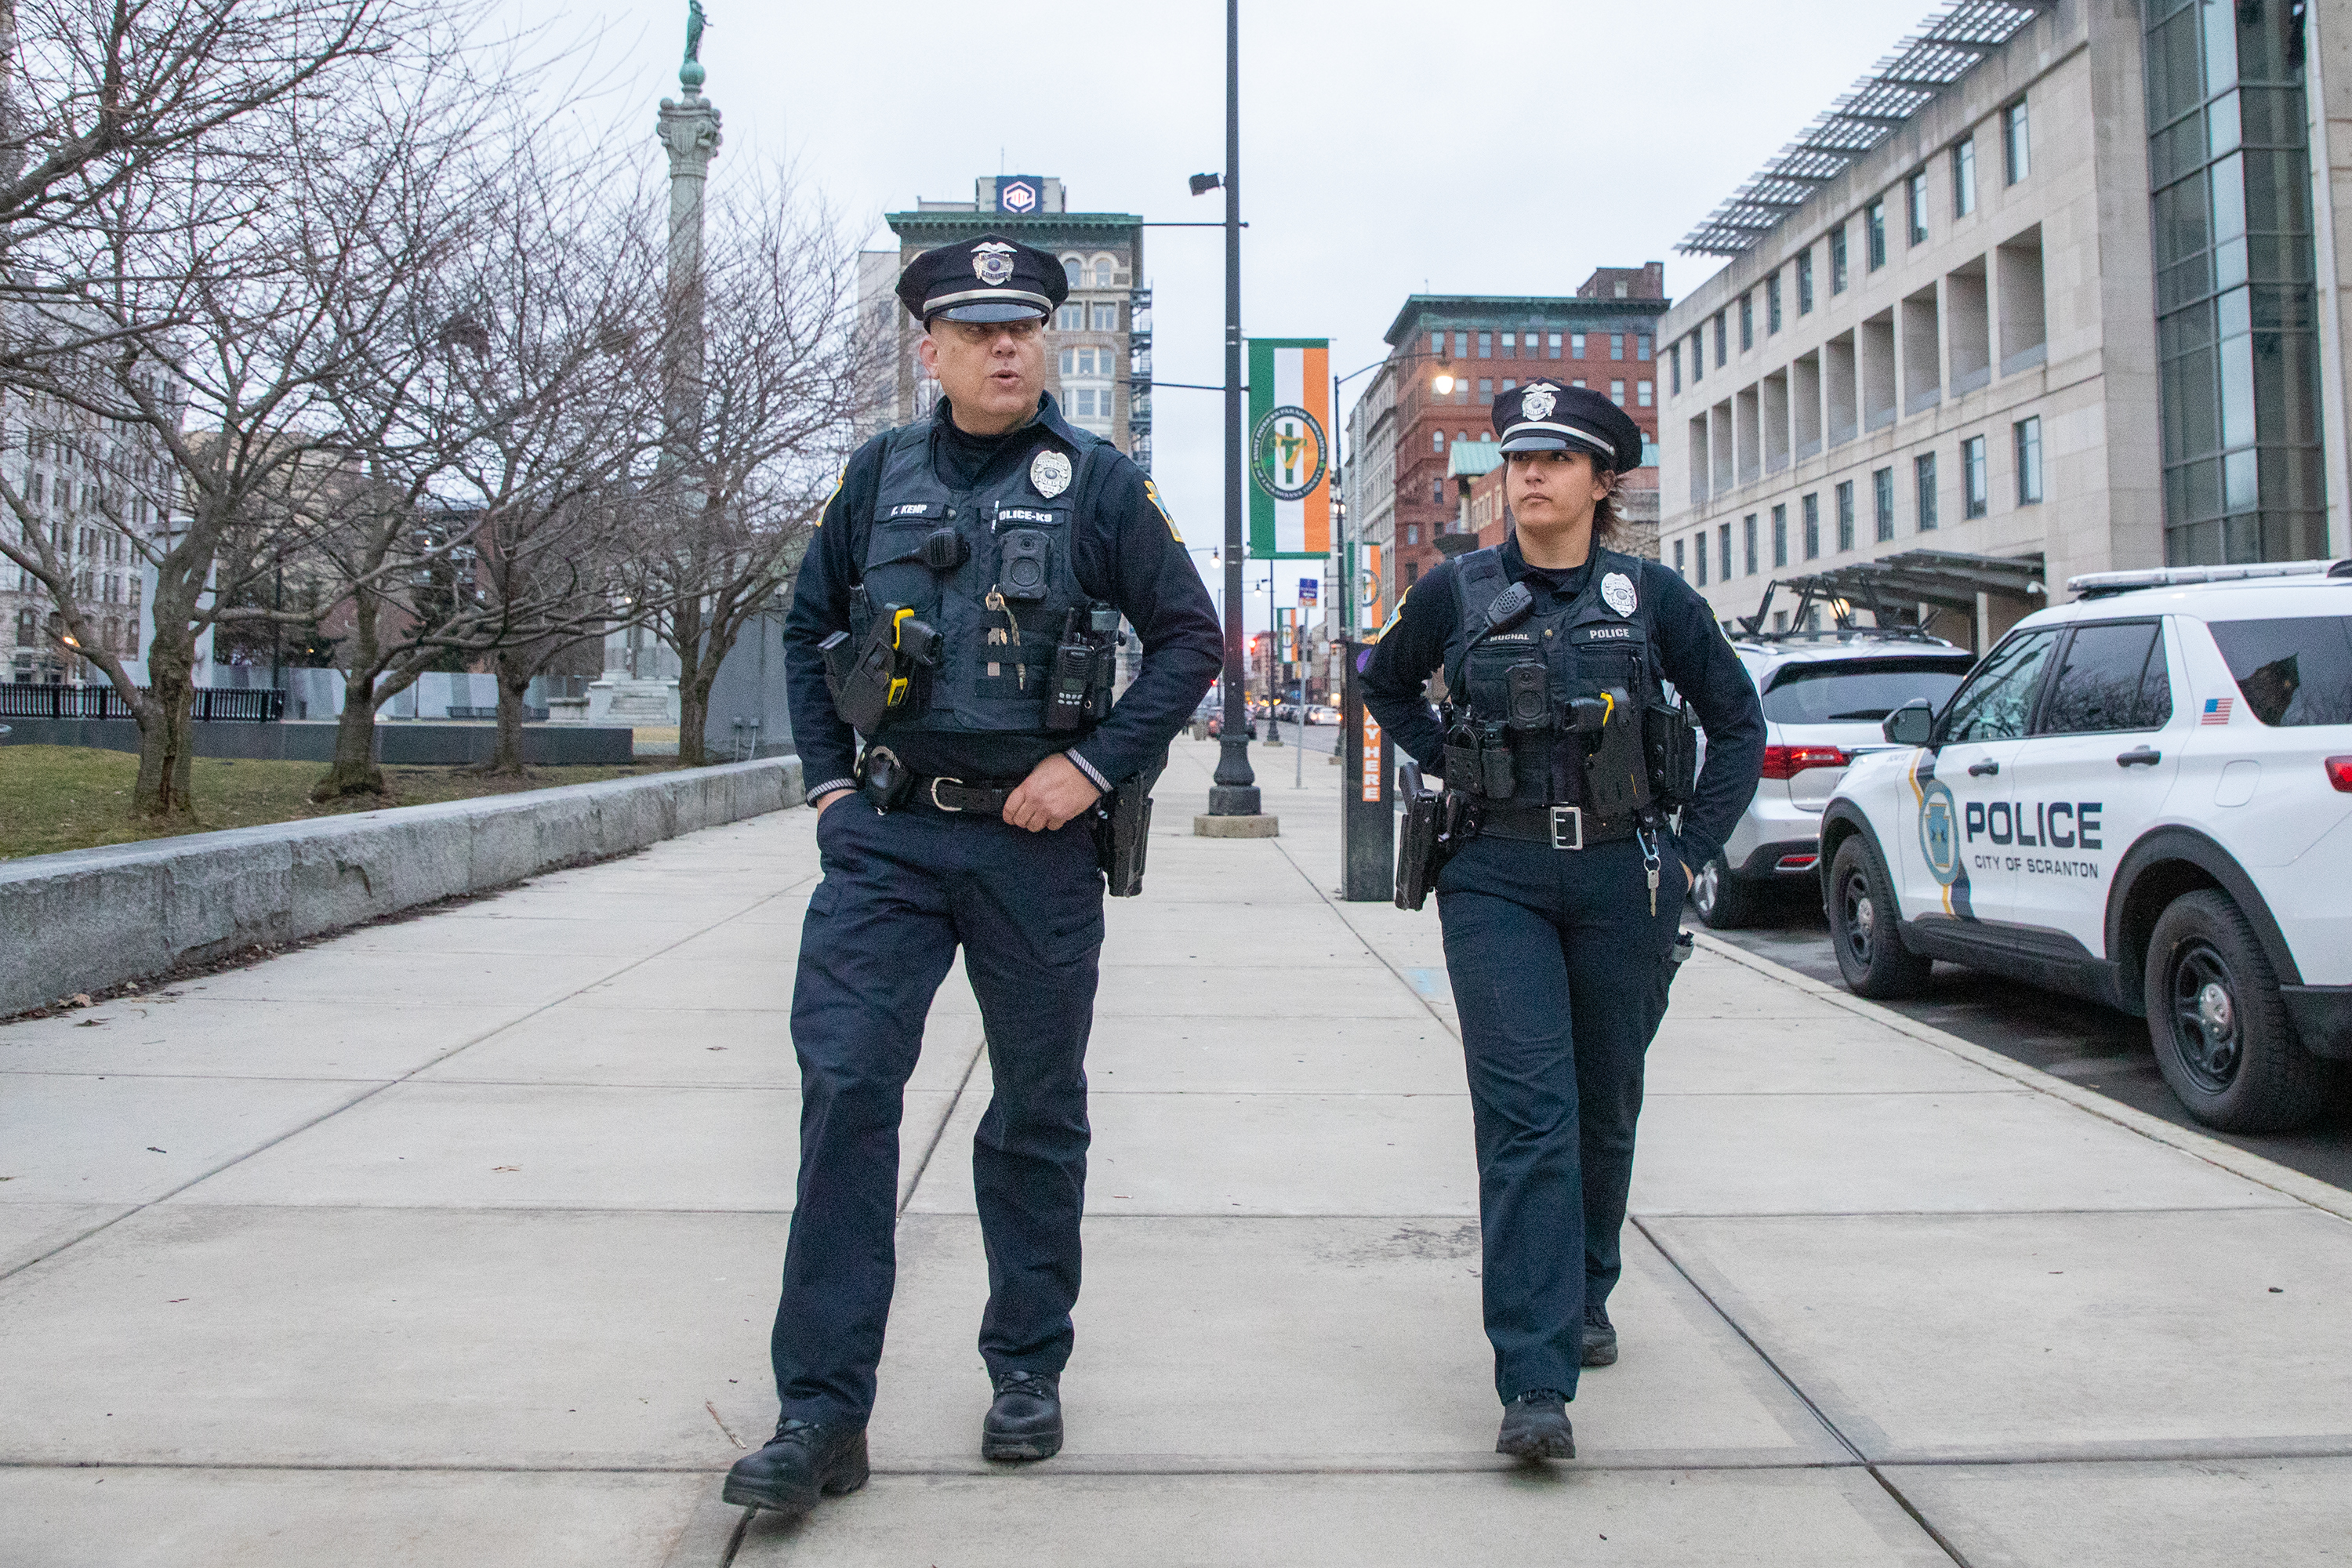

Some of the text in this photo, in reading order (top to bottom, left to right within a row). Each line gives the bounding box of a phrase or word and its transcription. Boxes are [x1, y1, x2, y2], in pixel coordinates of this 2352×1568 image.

[901, 504, 927, 514] KEMP
[992, 510, 1052, 522] OLICE-K9
[1589, 628, 1630, 639] POLICE
[1364, 708, 1380, 799] AY HERE
[1965, 802, 2103, 850] POLICE
[1974, 855, 2099, 878] CITY OF SCRANTON
